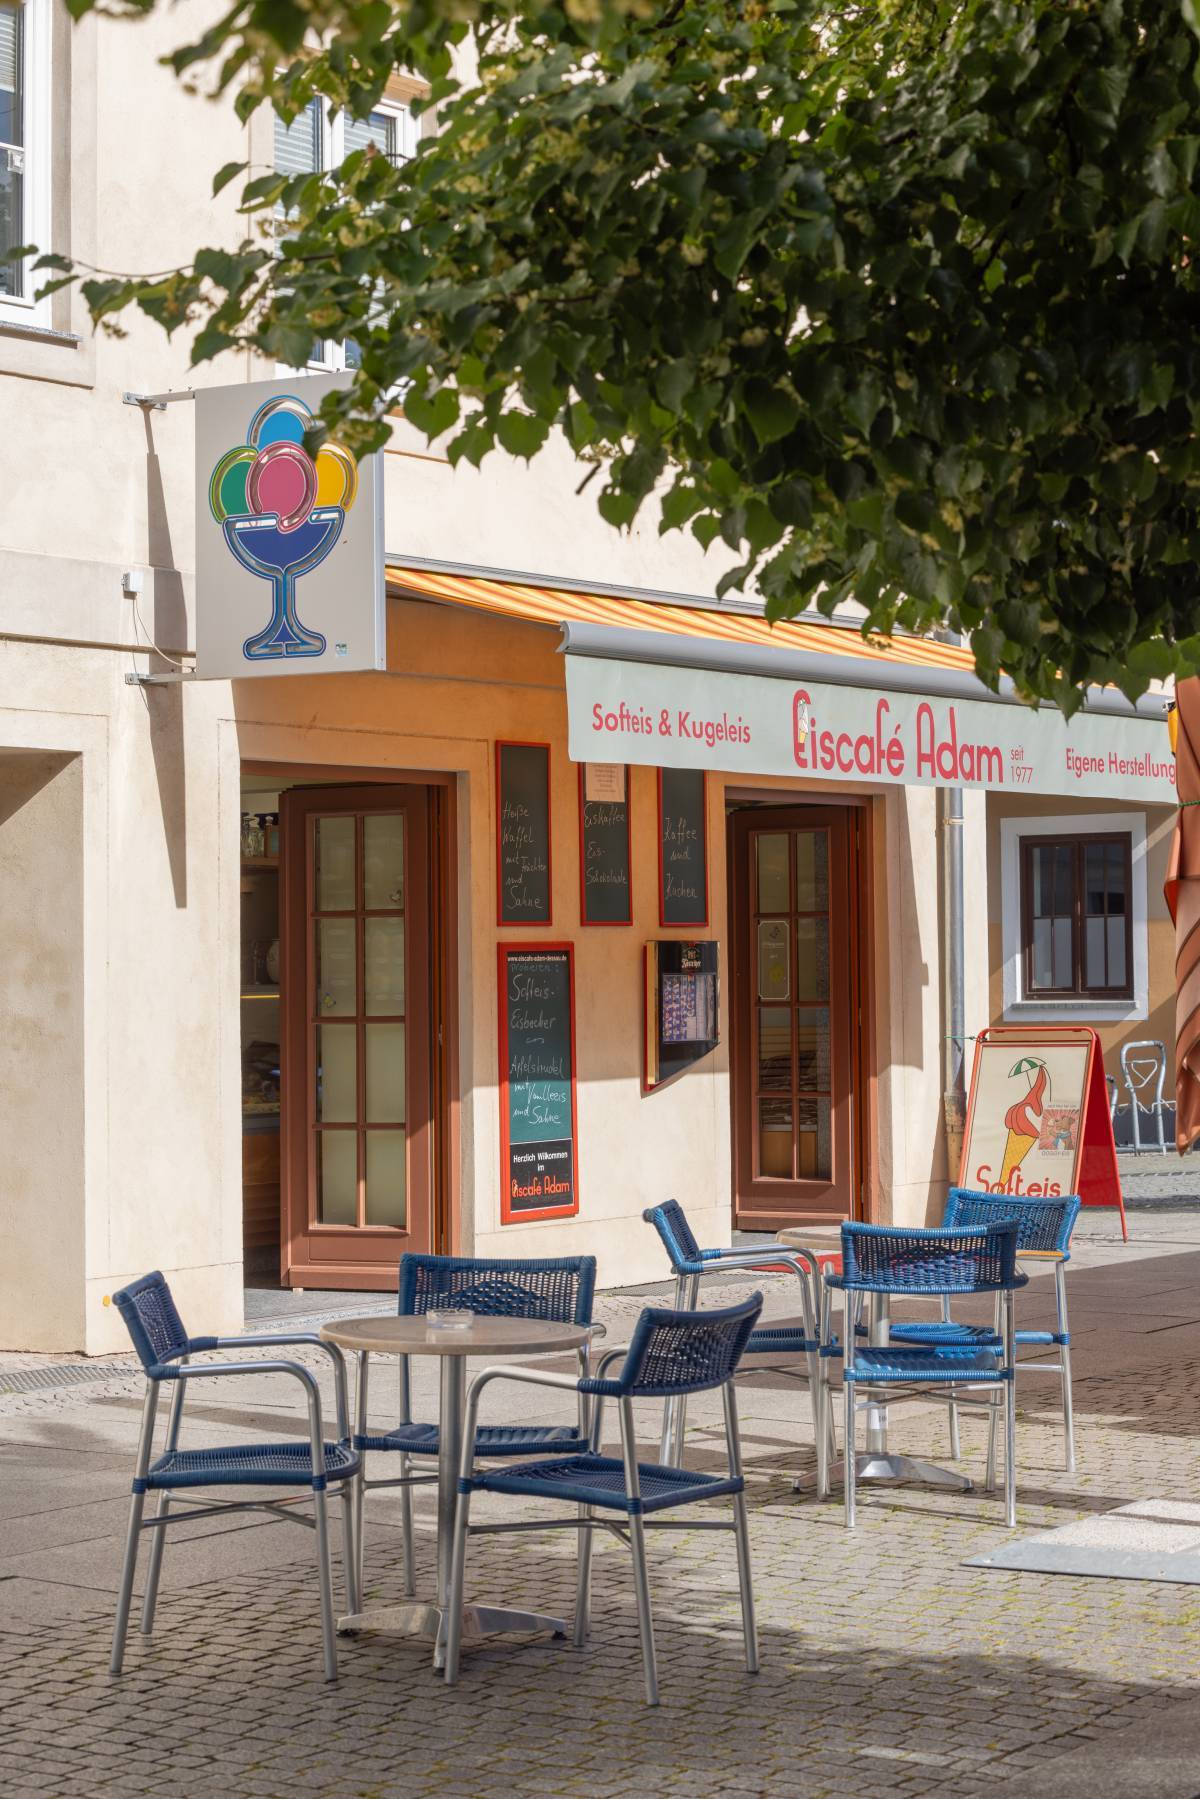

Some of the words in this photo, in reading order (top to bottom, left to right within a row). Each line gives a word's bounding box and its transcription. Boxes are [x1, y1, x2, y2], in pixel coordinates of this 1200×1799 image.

[592, 702, 653, 732] Softeis
[658, 709, 672, 736] &
[678, 711, 751, 748] Kugeleis
[792, 689, 905, 776] Eiscafé
[916, 702, 1004, 784] Adam
[1010, 744, 1024, 761] seit
[1010, 765, 1034, 784] 1977
[1065, 747, 1105, 778] Eigene
[1108, 751, 1177, 784] Herstellung
[506, 886, 544, 910] Sahne
[664, 873, 698, 899] Kuchen
[509, 1054, 566, 1079] Apfelstrudel
[528, 1105, 561, 1125] Sahne
[513, 1153, 536, 1163] Herzlich
[537, 1163, 545, 1172] im
[544, 1175, 570, 1194] Adam
[976, 1165, 1061, 1198] Softeis
